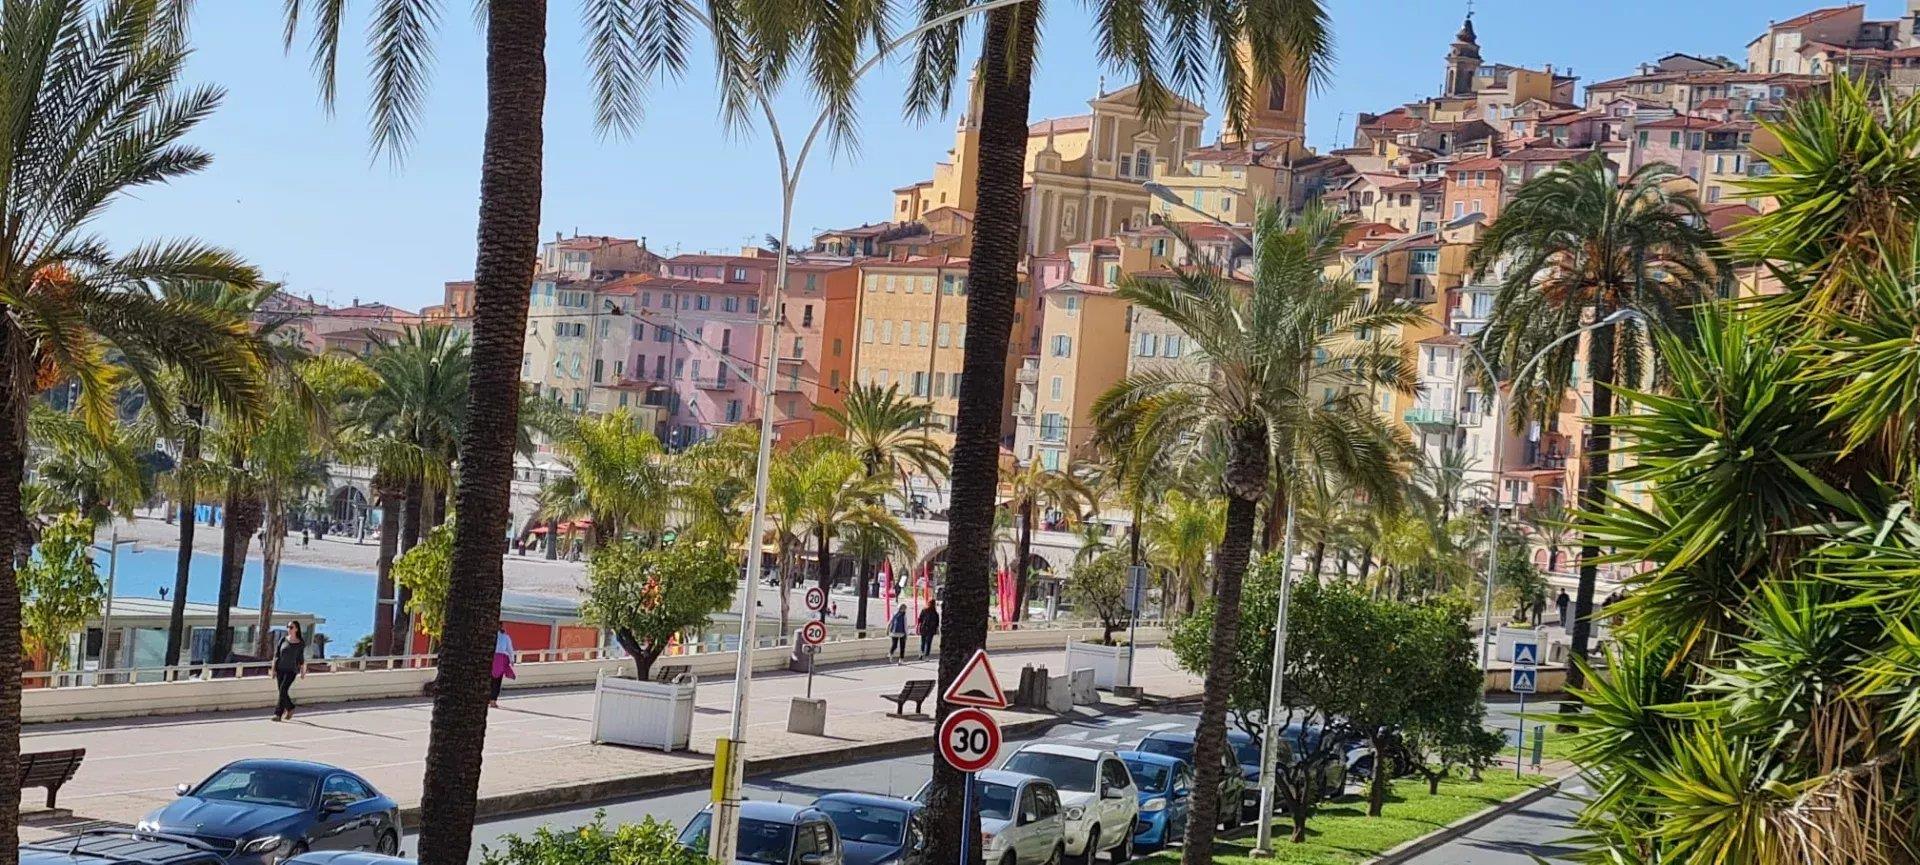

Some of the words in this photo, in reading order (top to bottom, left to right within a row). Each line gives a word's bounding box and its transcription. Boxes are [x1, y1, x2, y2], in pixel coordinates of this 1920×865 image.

[810, 594, 820, 604] 20
[808, 628, 821, 638] 20
[953, 727, 988, 755] 30
